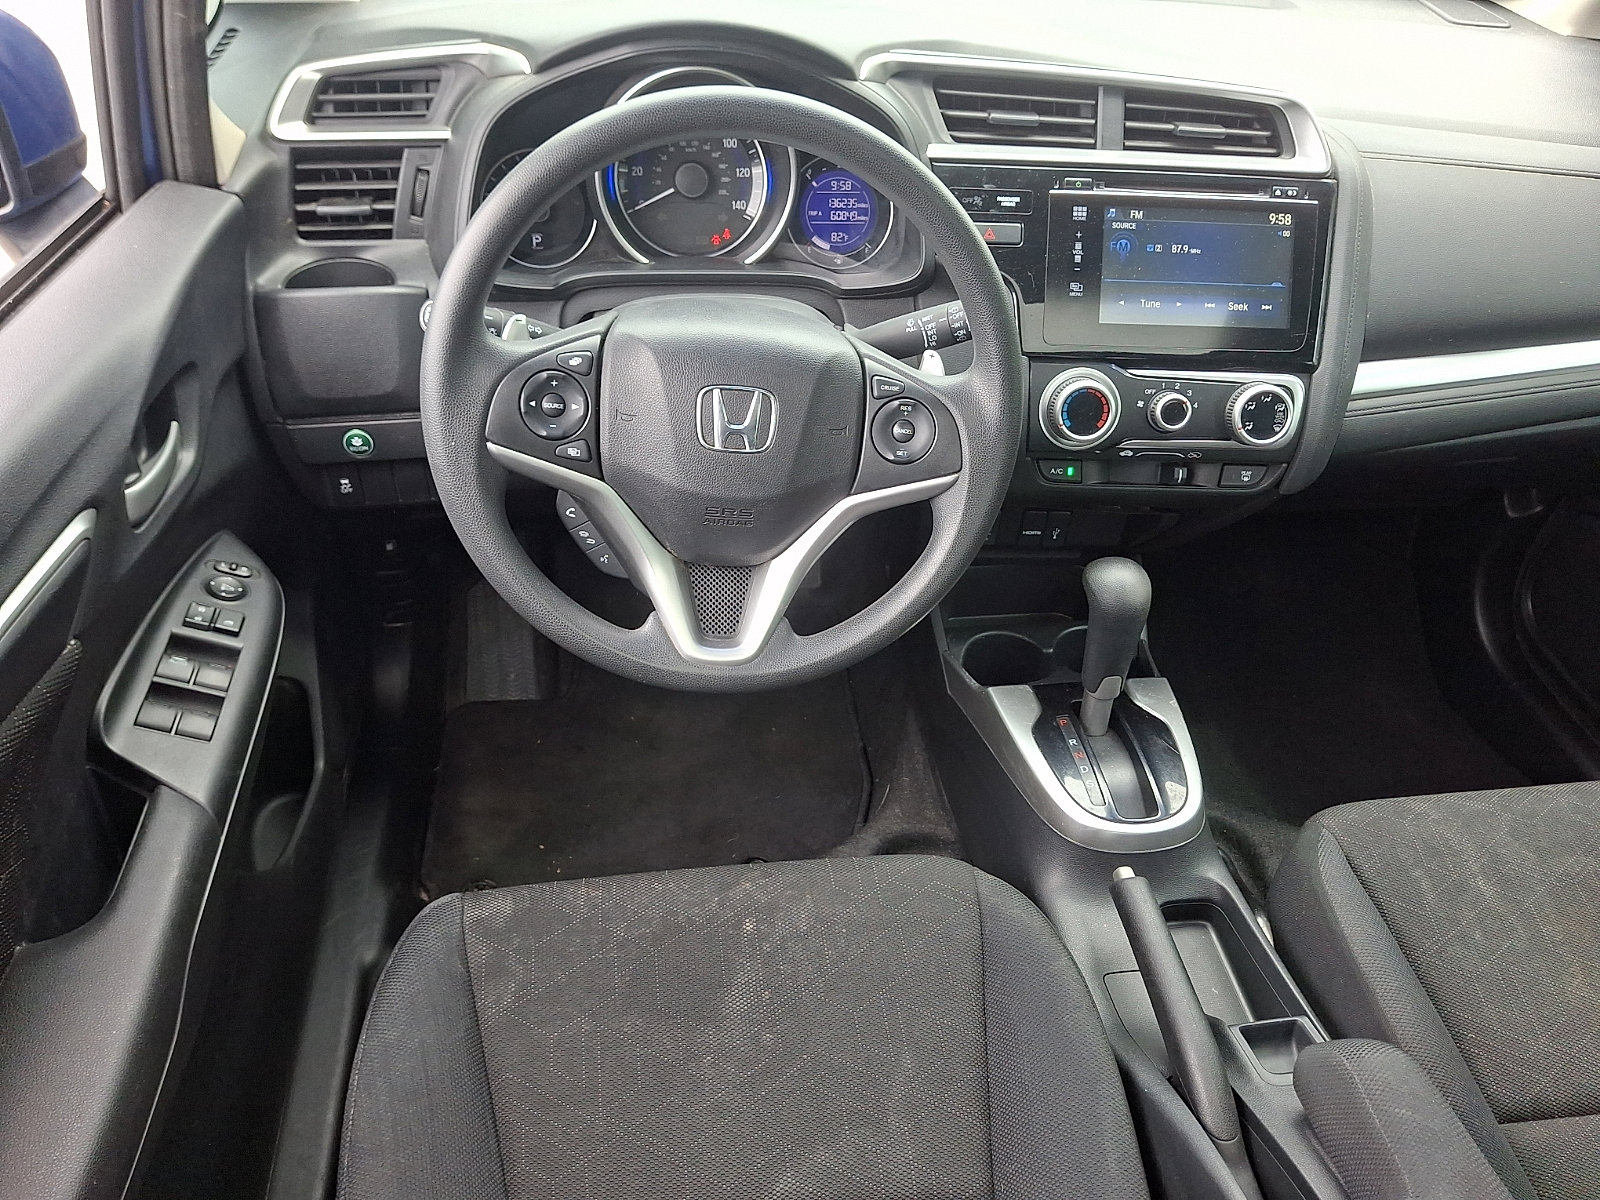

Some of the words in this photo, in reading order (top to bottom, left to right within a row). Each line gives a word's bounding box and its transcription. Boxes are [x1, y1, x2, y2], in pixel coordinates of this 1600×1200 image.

[723, 138, 737, 148] 100
[632, 166, 643, 176] 20
[735, 167, 750, 177] 120
[830, 180, 852, 191] 9:58
[731, 200, 746, 210] 140
[828, 198, 857, 208] 136235
[1129, 210, 1144, 220] FM
[1268, 213, 1292, 226] 9:58
[1111, 222, 1137, 230] SOURCE
[1171, 244, 1189, 253] 87.9
[1140, 299, 1161, 309] Tune
[1227, 301, 1249, 312] Seek
[924, 322, 936, 330] OFF
[1174, 382, 1180, 390] 2
[1186, 389, 1192, 397] 3
[1050, 467, 1064, 475] A/C
[705, 506, 754, 519] SRS
[1068, 738, 1078, 746] R
[1080, 765, 1089, 773] D
